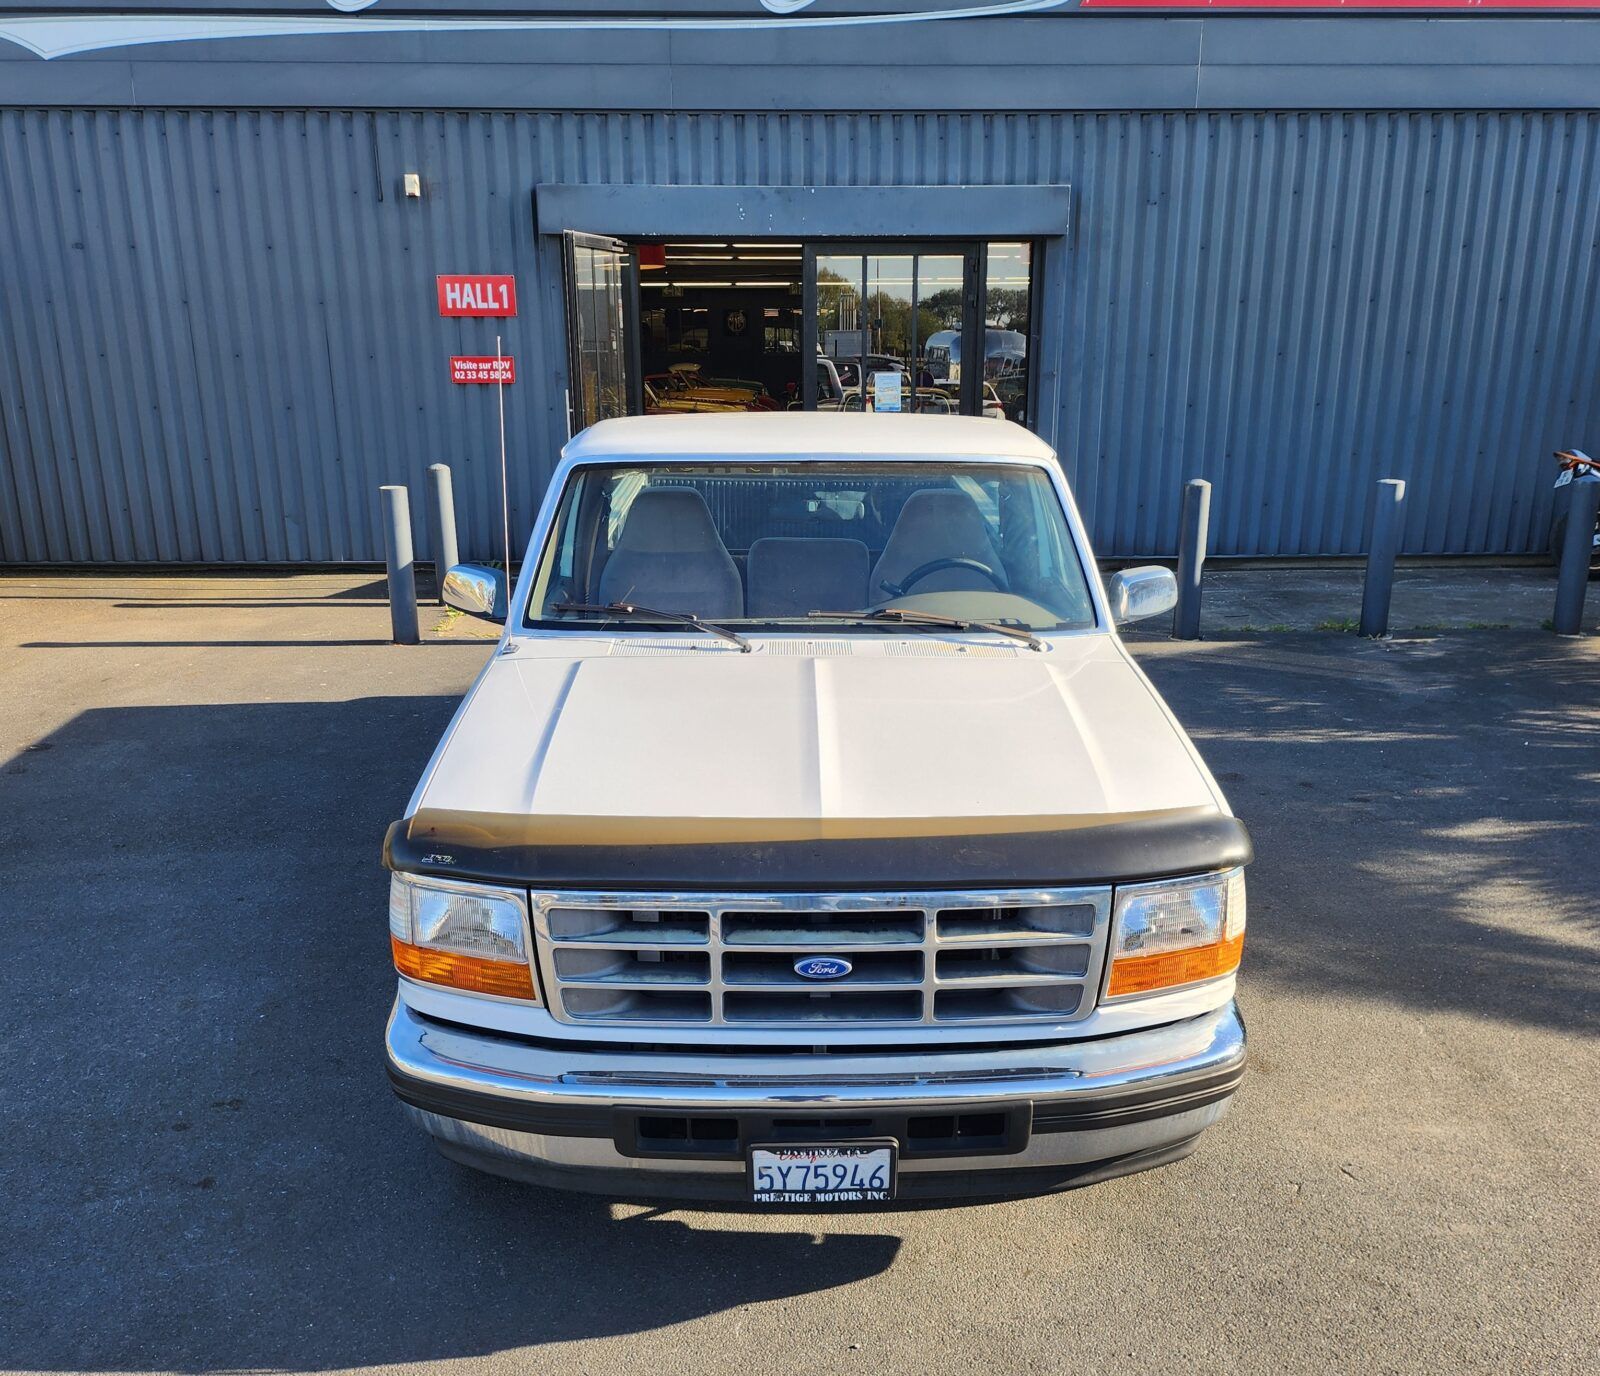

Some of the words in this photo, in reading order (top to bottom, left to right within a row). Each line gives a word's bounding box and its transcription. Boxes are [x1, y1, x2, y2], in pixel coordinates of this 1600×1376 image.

[454, 361, 478, 370] Visite
[478, 362, 492, 370] sur
[492, 361, 511, 370] RDV
[455, 371, 465, 379] 02
[466, 371, 477, 379] 33
[478, 371, 488, 379] 45
[489, 371, 500, 379] 58
[501, 371, 512, 379] 24
[808, 962, 838, 974] Ford
[758, 1164, 885, 1190] 5Y75946
[815, 1191, 864, 1202] MOTORS
[866, 1191, 891, 1201] INC.
